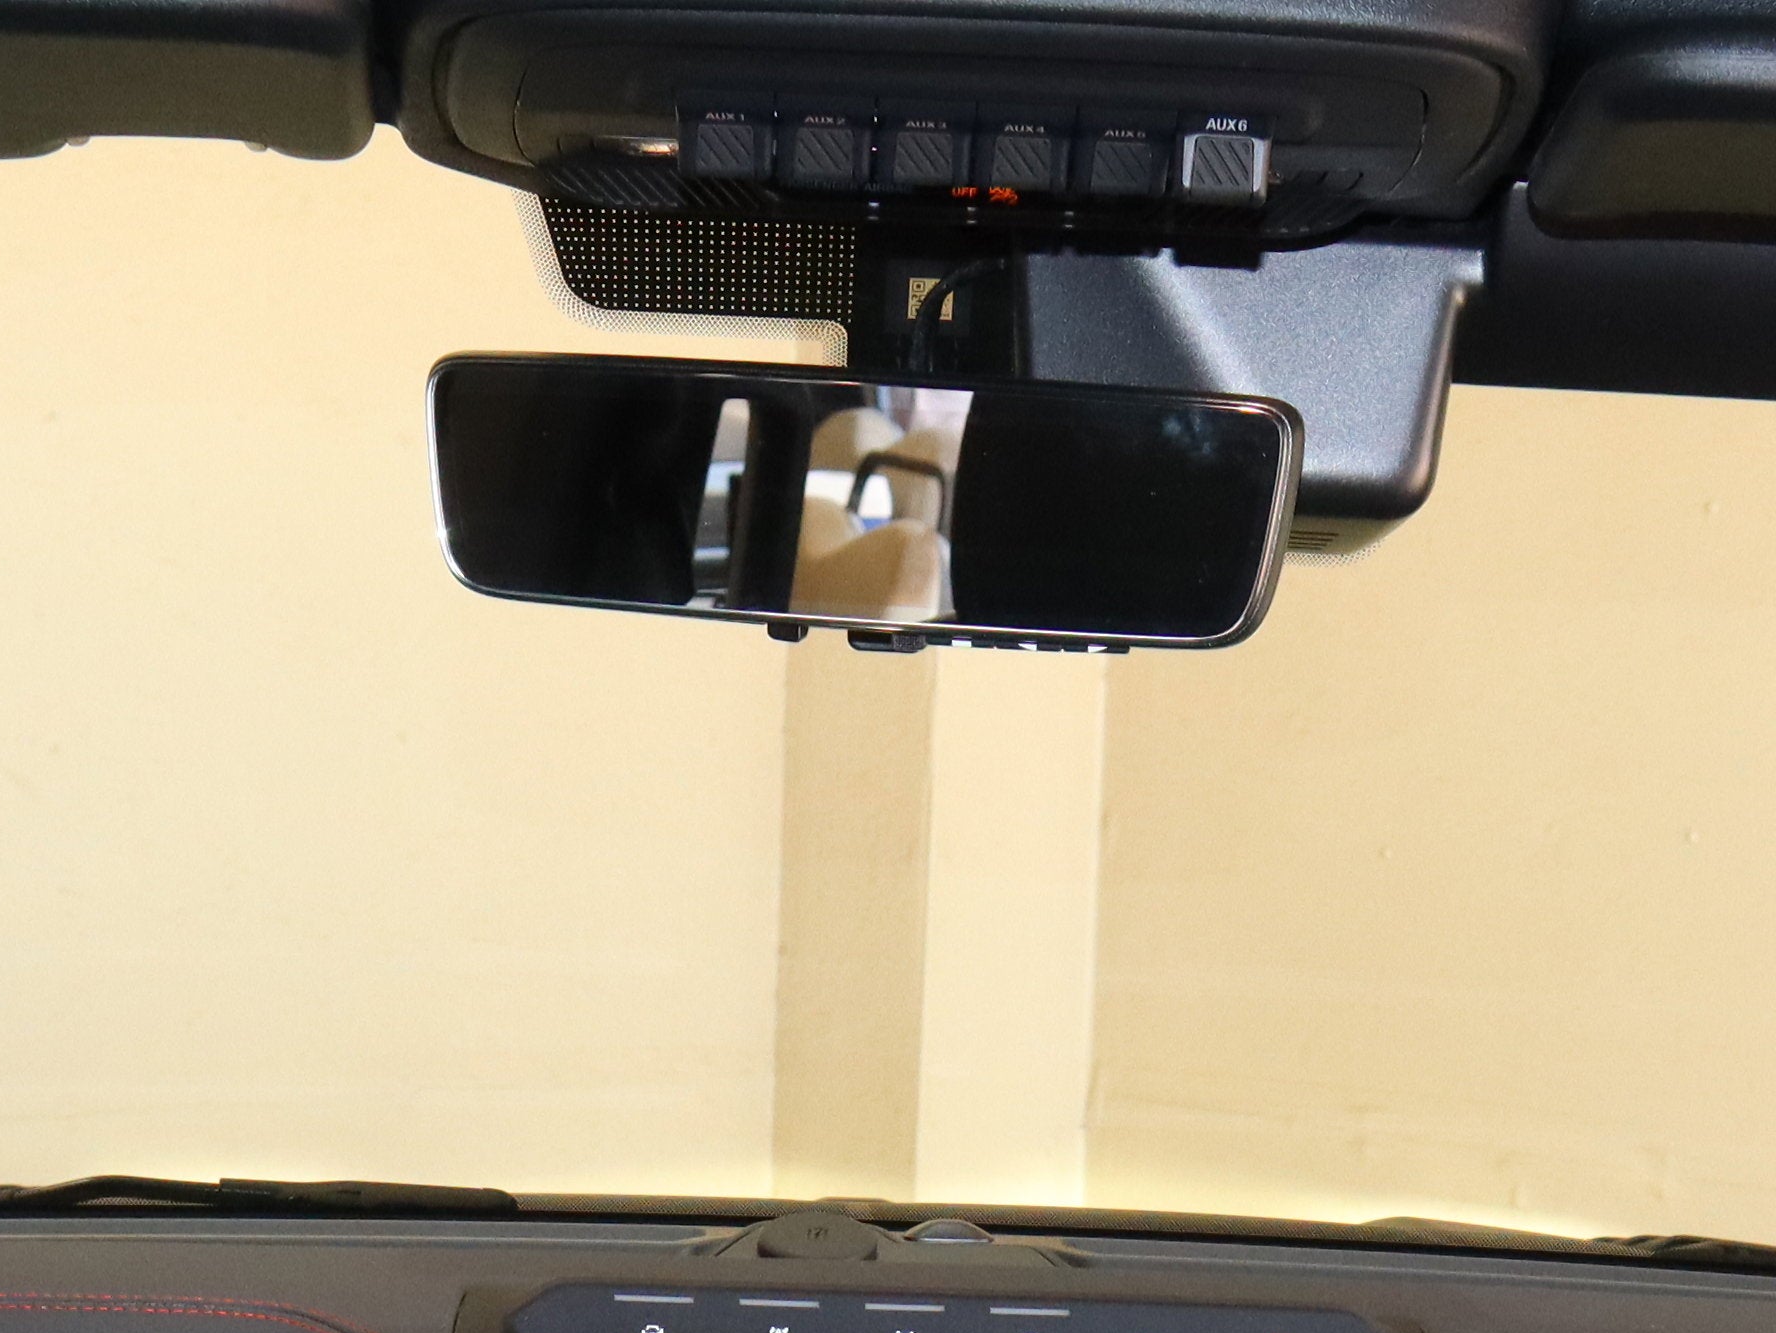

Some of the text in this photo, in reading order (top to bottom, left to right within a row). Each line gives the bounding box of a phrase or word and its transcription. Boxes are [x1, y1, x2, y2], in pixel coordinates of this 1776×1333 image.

[705, 112, 736, 121] AUX
[804, 116, 833, 124] AUX
[906, 120, 937, 128] AUX
[1004, 124, 1033, 132] AUX
[1206, 117, 1236, 131] AUX
[1104, 129, 1133, 137] AUX
